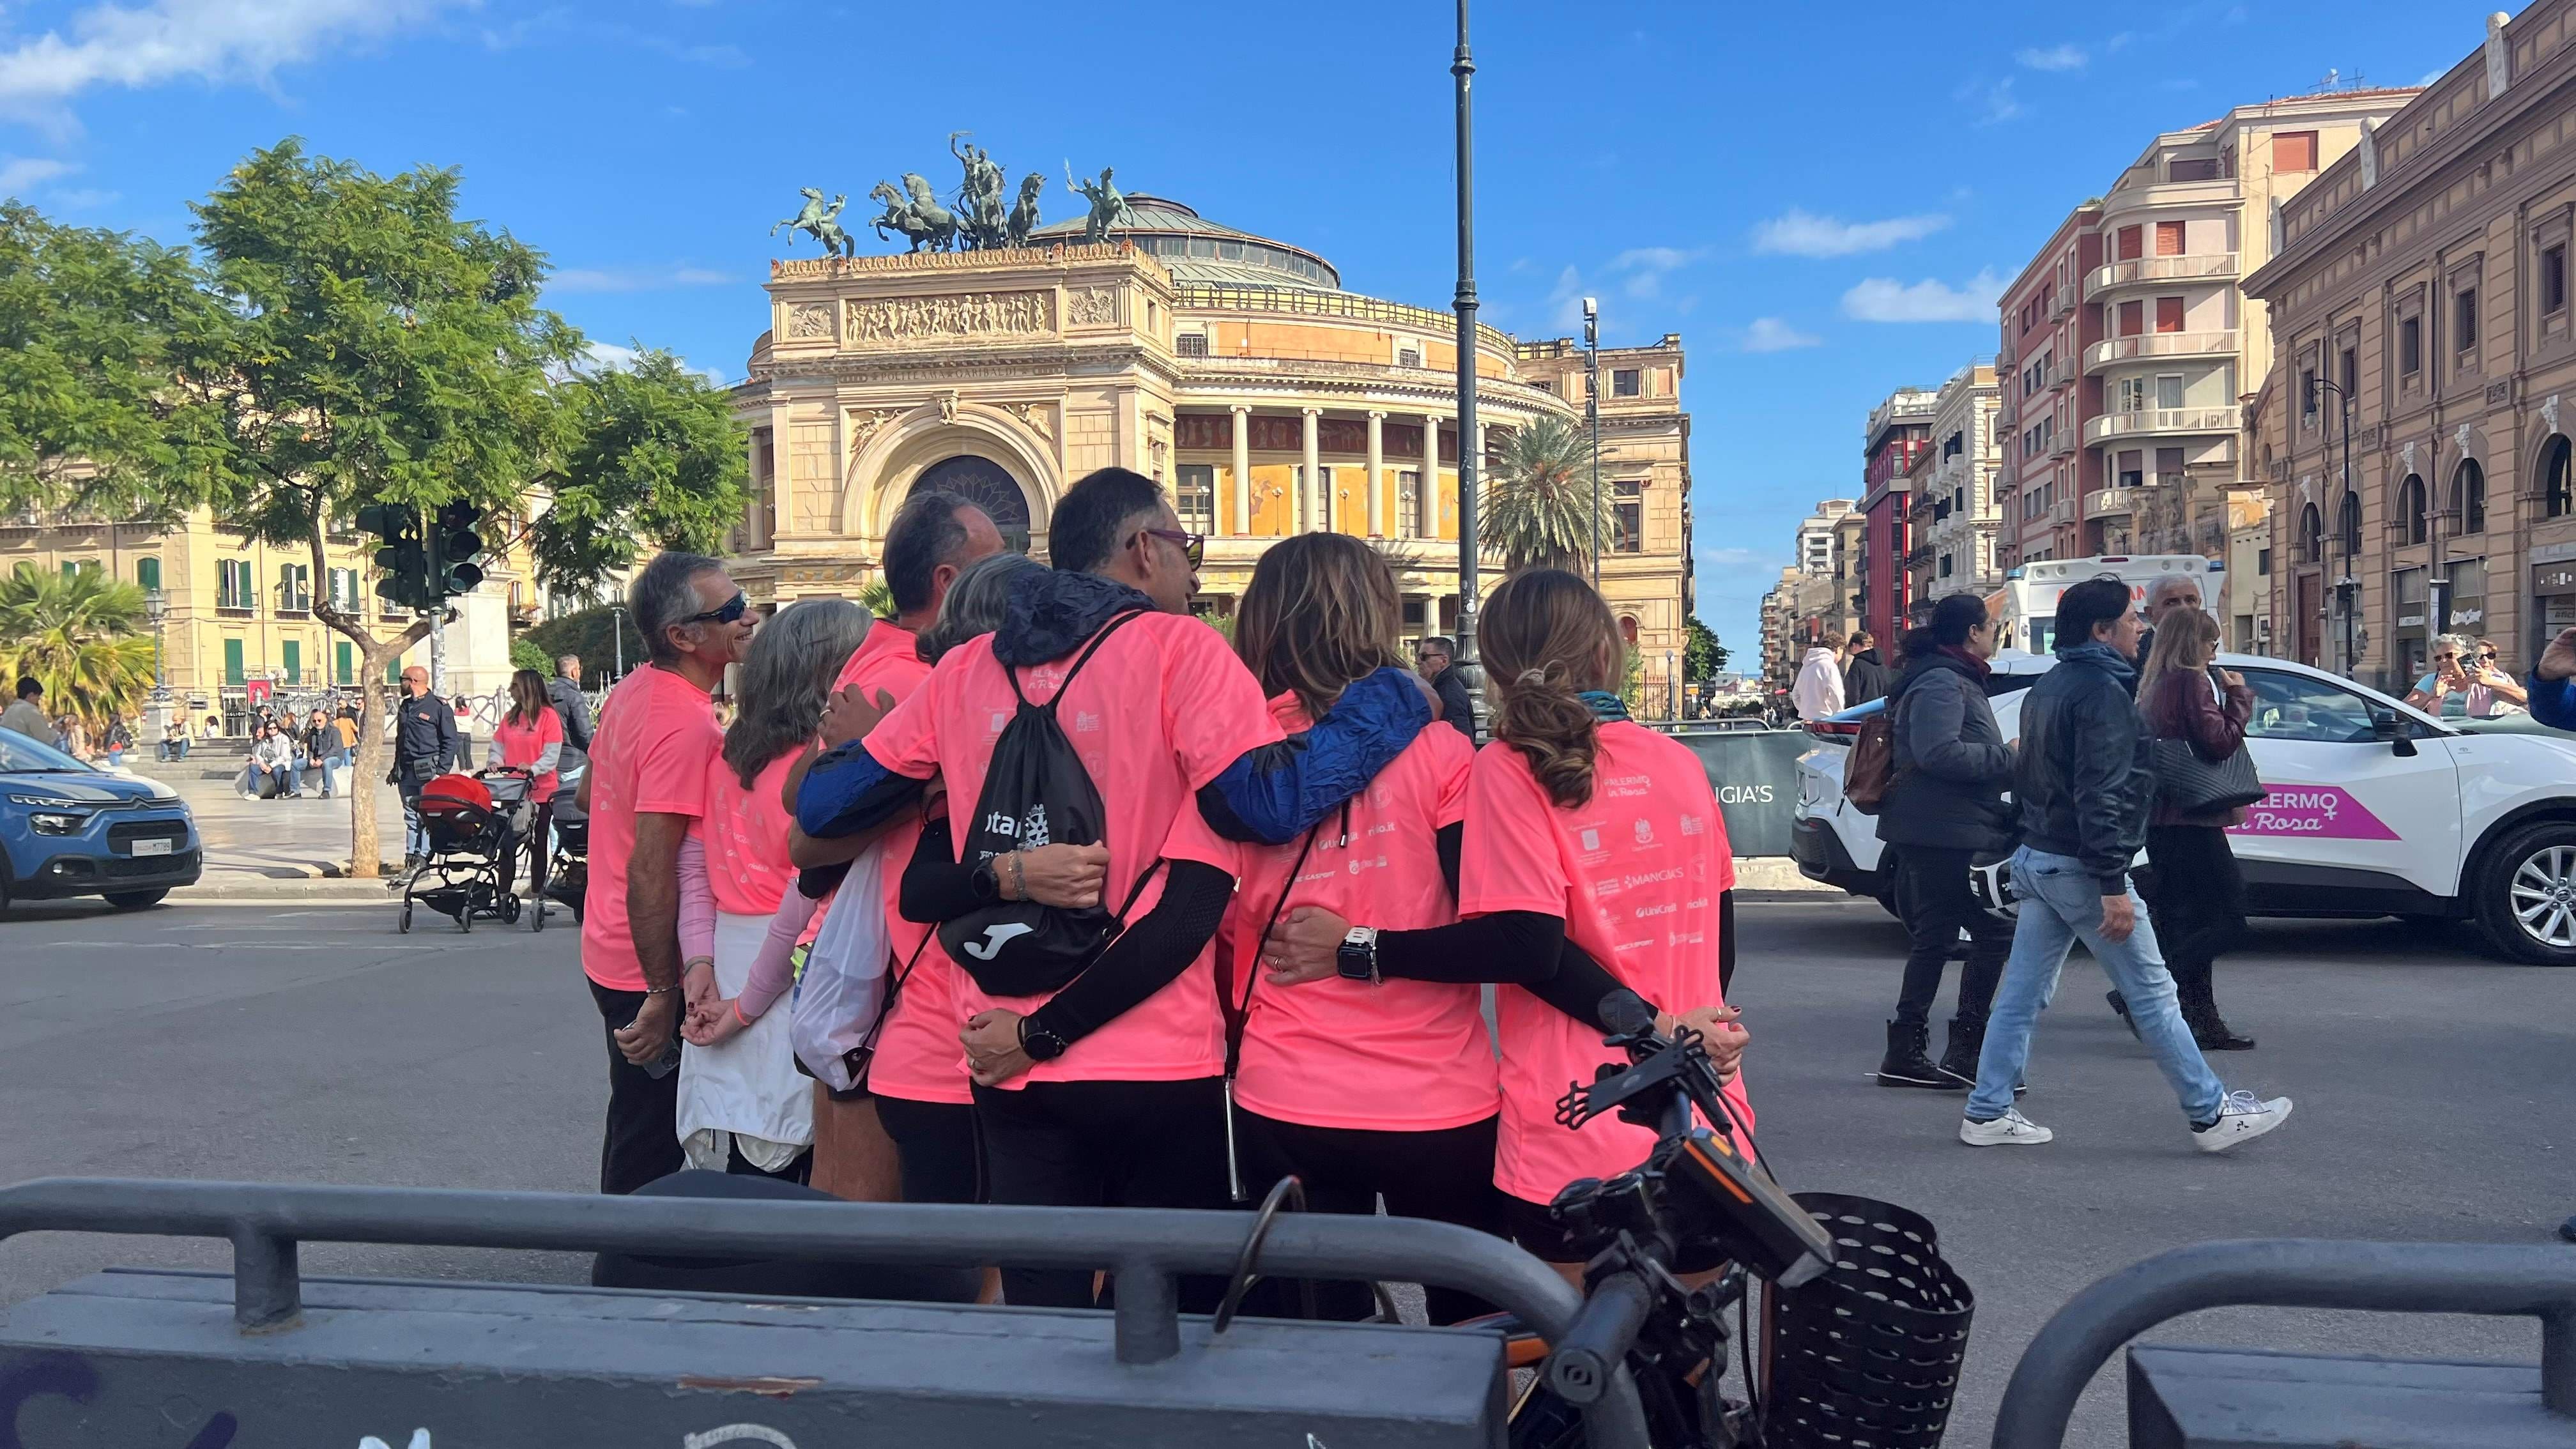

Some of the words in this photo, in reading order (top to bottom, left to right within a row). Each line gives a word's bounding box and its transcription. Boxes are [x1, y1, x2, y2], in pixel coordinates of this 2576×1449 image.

[882, 370, 945, 381] POLITEAMA
[955, 367, 1016, 378] GARIBALDI
[1604, 776, 1652, 787] PALERMO
[2250, 792, 2338, 816] LERMO
[2254, 812, 2323, 831] Rosa
